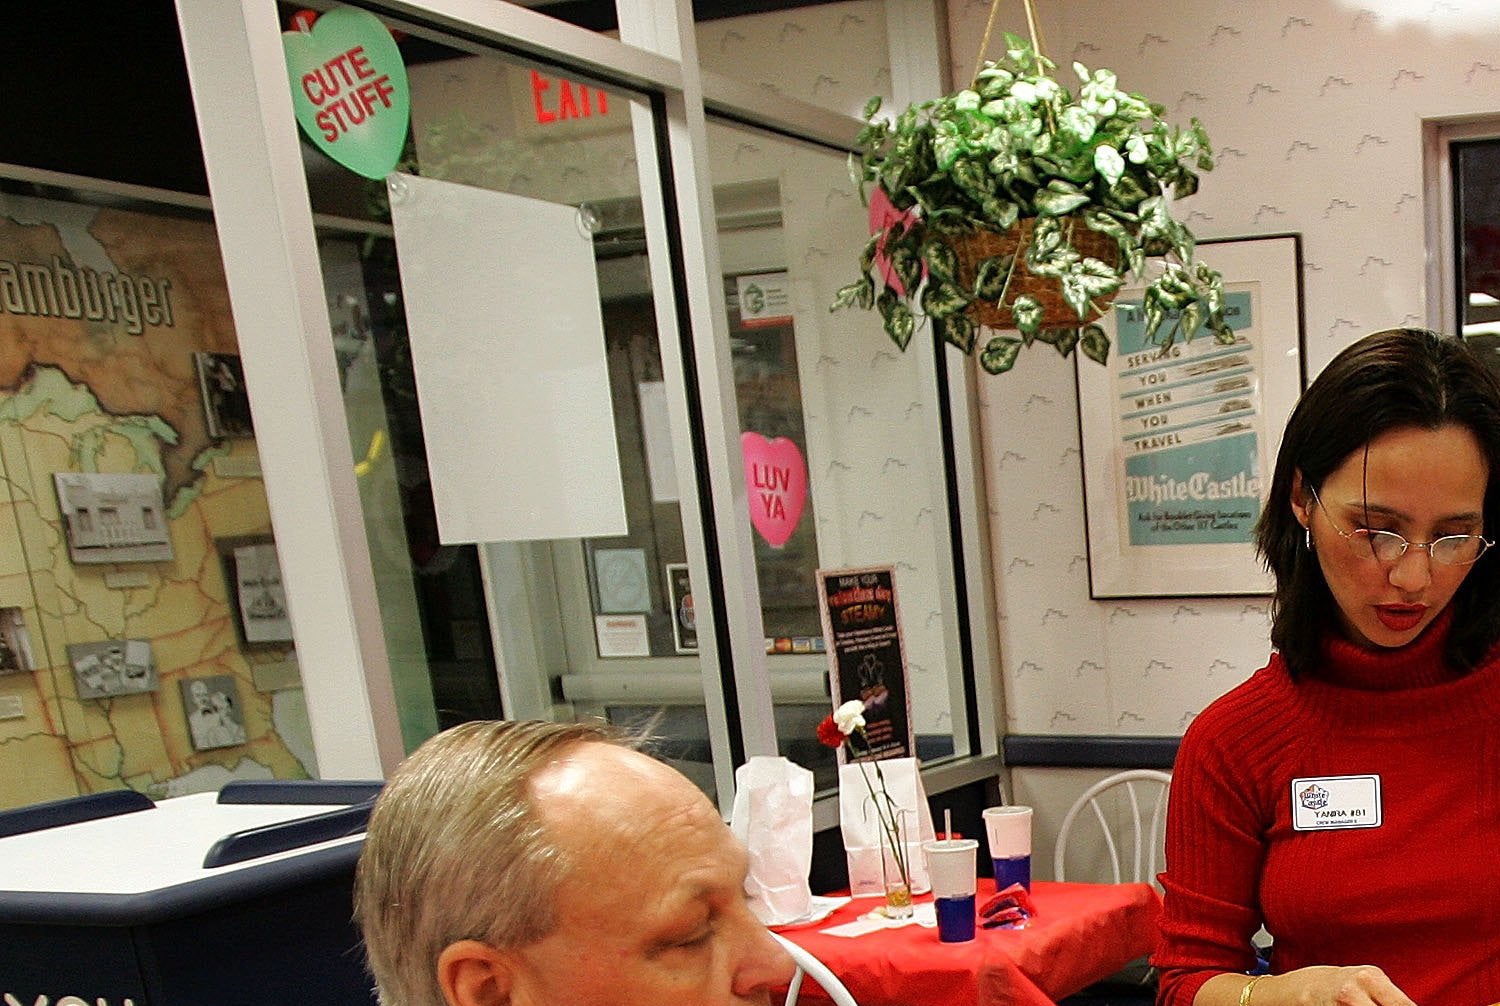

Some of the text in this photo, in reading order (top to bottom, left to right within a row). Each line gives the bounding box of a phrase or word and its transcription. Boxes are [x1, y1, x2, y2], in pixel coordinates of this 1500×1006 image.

[302, 45, 377, 106] CUTE
[315, 74, 395, 143] STUFF
[0, 255, 173, 335] amburger
[1128, 347, 1181, 368] SERVNG
[1139, 372, 1167, 386] YOU
[1135, 392, 1172, 409] WHEN
[1141, 415, 1169, 428] YOU
[1134, 433, 1182, 451] TRAVEL
[753, 463, 790, 492] LUV
[1127, 471, 1262, 506] White Castle
[761, 493, 785, 520] YA
